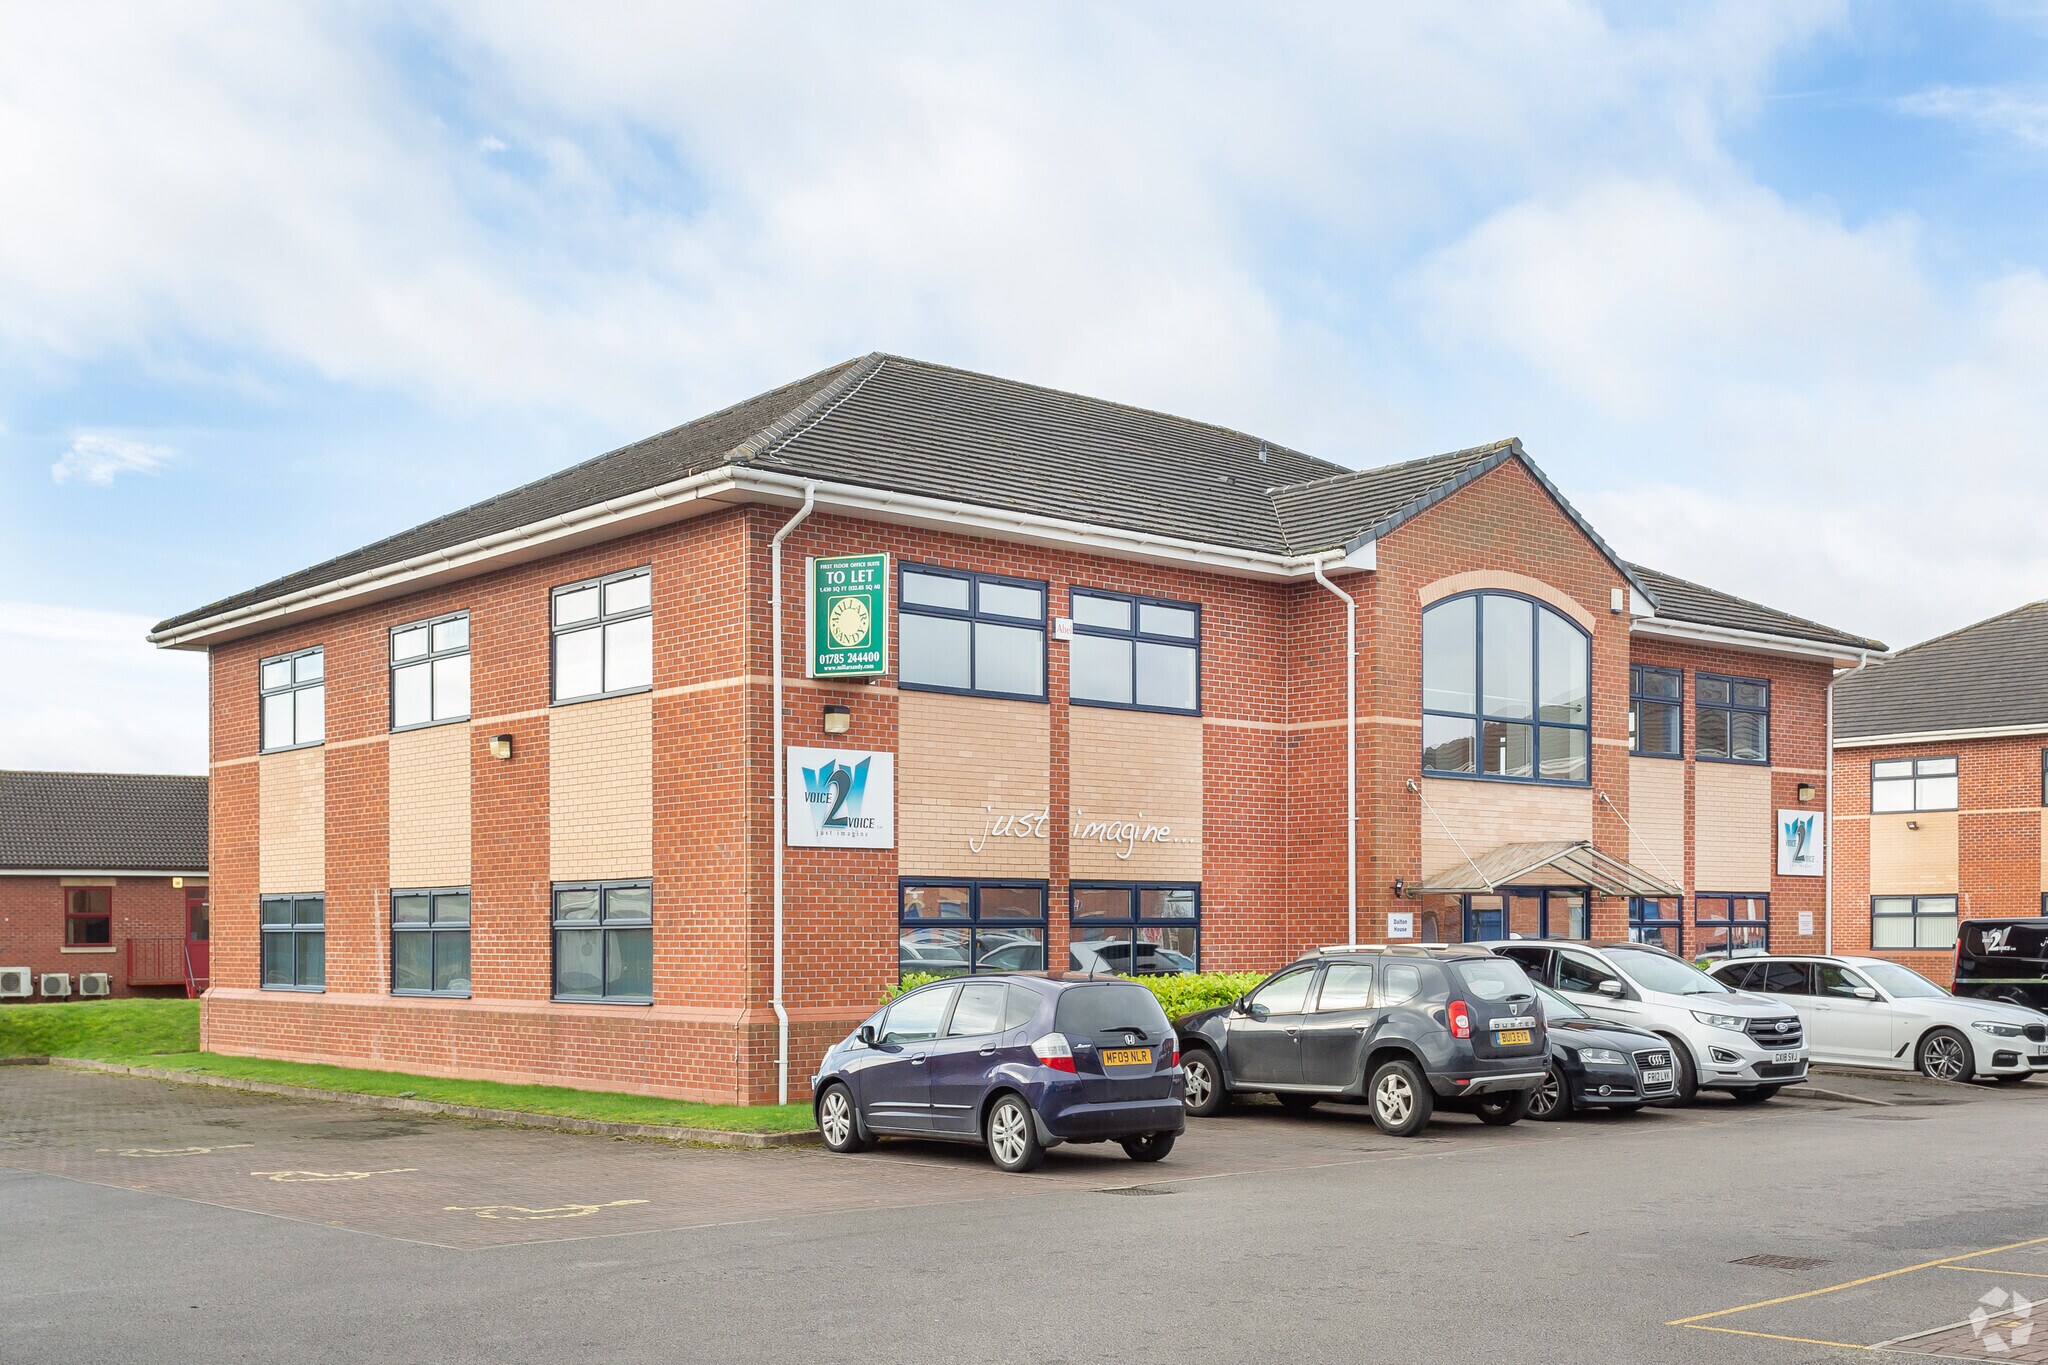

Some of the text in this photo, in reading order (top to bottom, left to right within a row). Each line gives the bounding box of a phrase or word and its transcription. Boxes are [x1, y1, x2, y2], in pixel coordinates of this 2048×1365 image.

[826, 569, 875, 584] TO LET
[832, 600, 867, 623] MILLAR
[833, 626, 865, 643] SANDY
[1057, 624, 1072, 635] Abel
[819, 651, 880, 664] 01785 244400
[804, 768, 876, 829] VOICE 2 VOICE
[816, 829, 869, 838] just imagine
[969, 805, 1195, 860] just imagine...
[1795, 824, 1806, 862] 2
[1494, 1021, 1535, 1029] DUSTER
[1106, 1050, 1147, 1064] MF09 NLR
